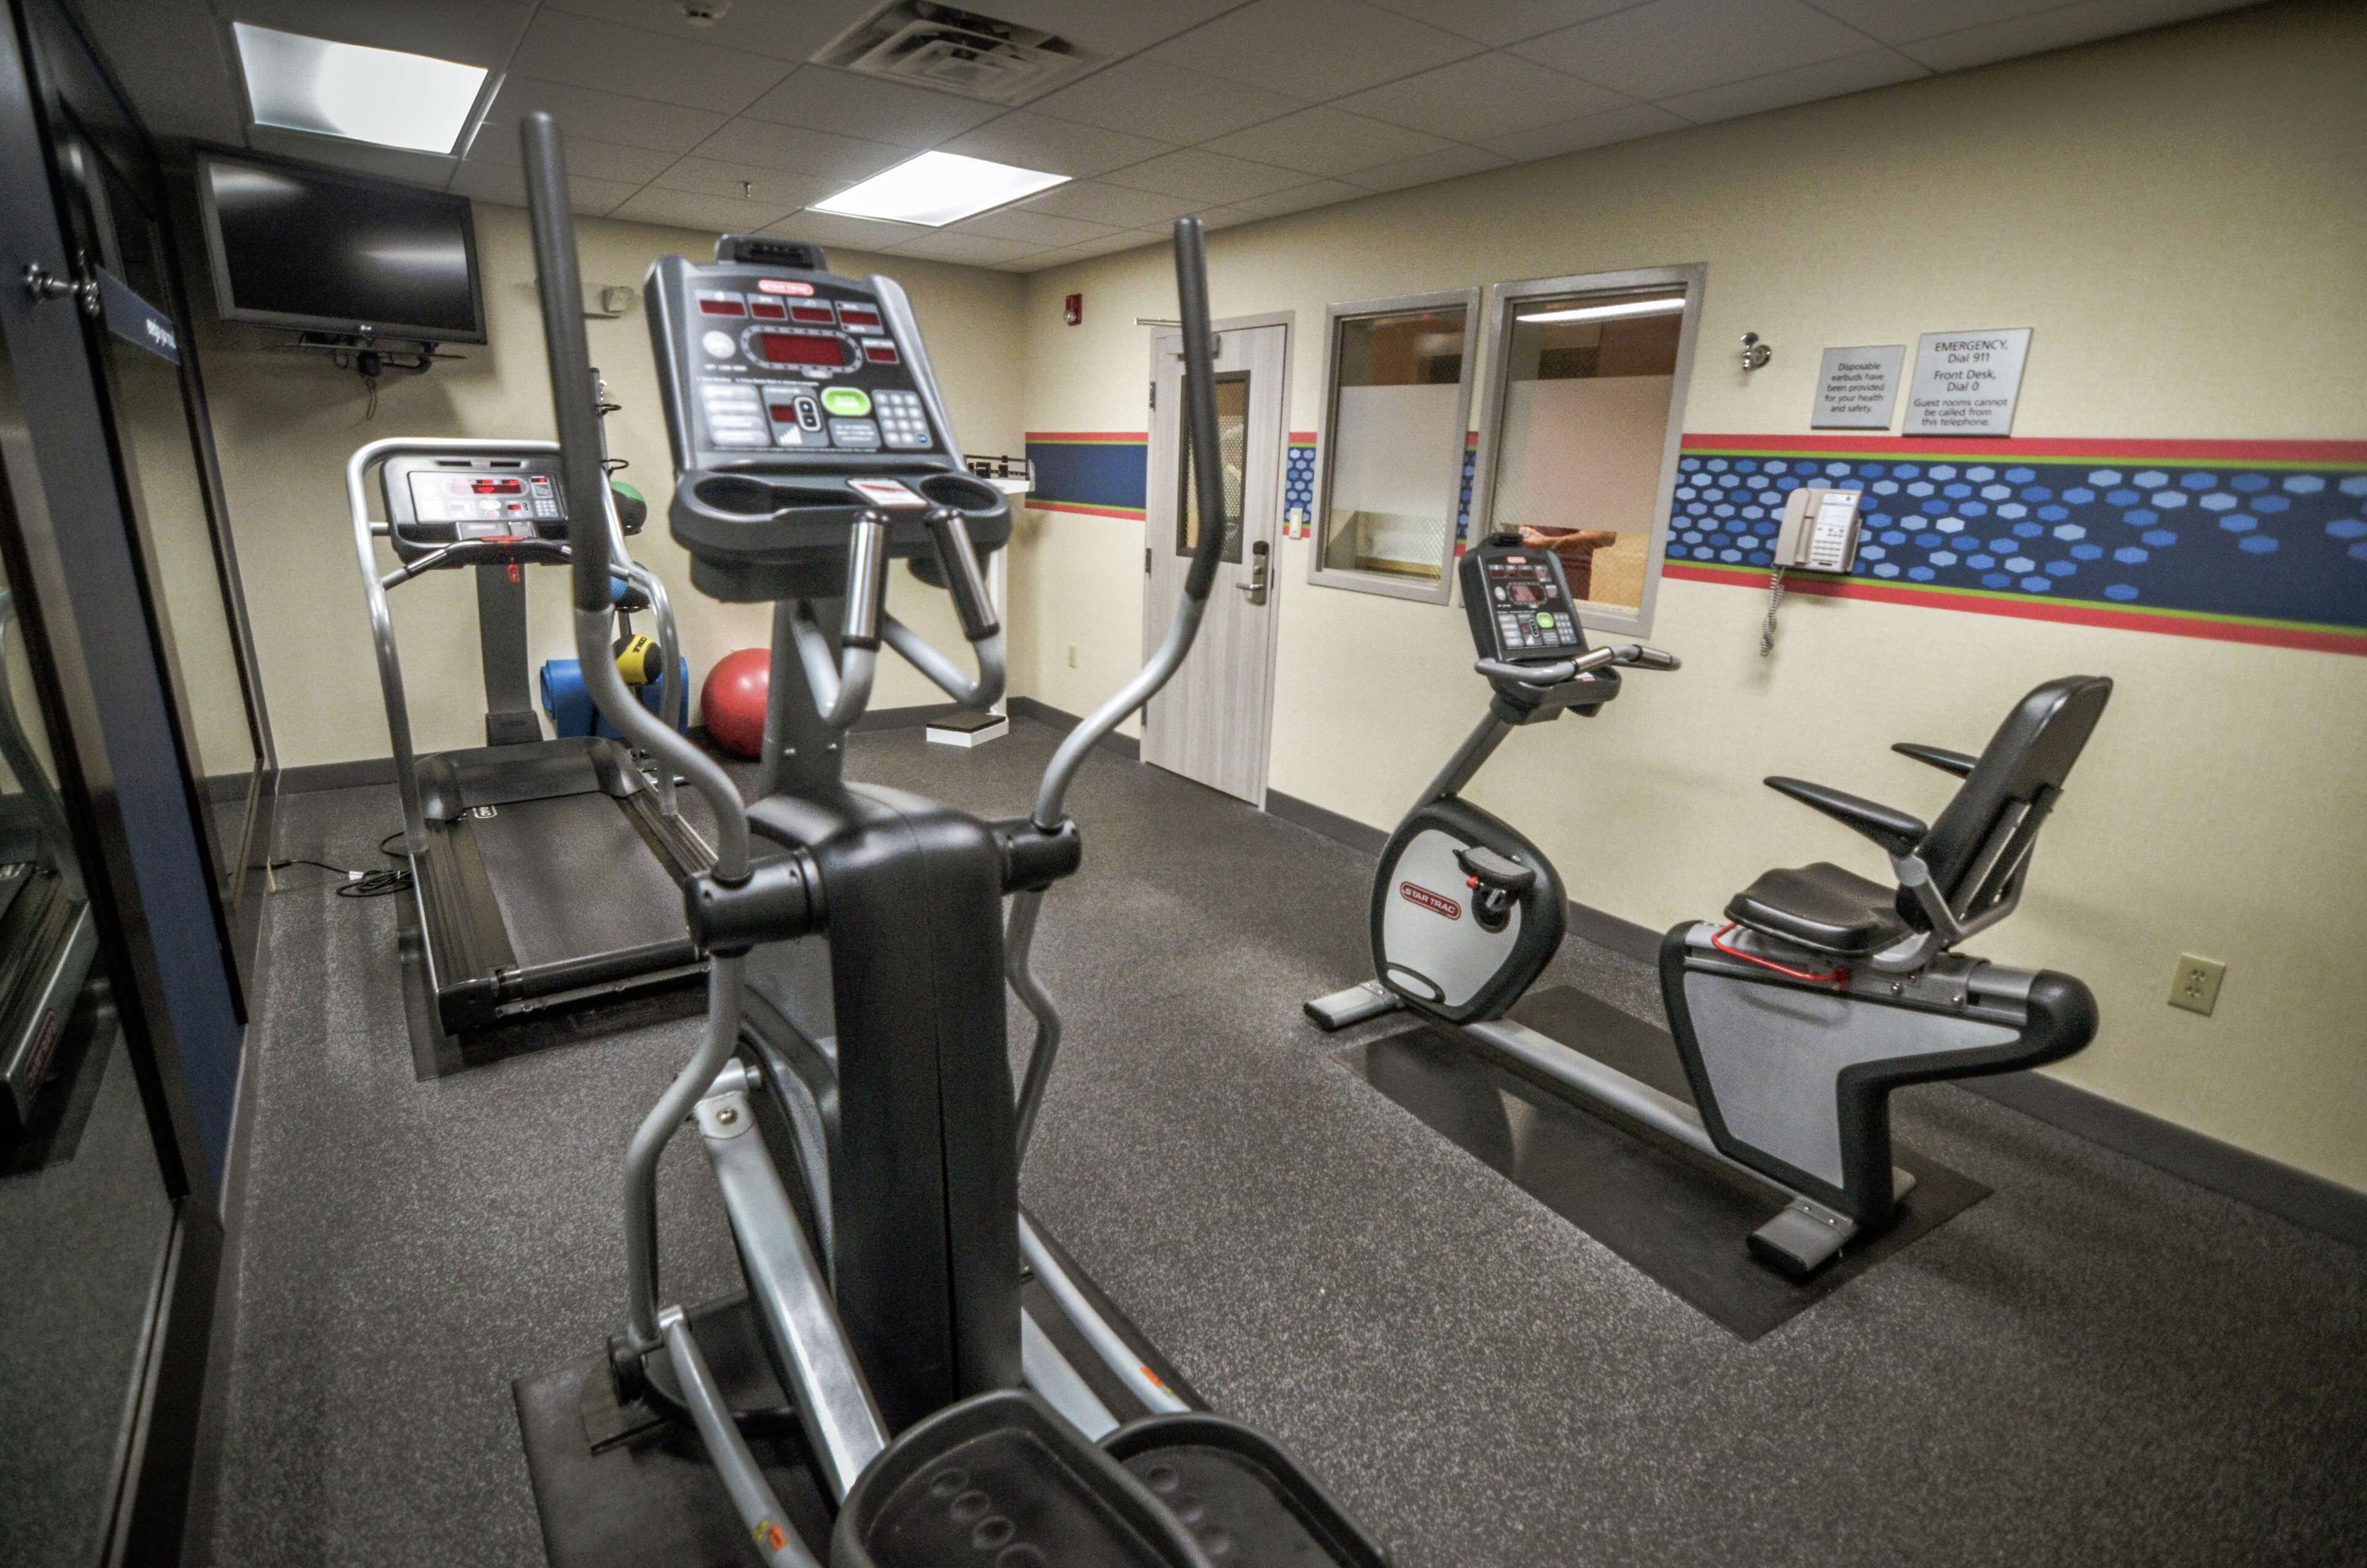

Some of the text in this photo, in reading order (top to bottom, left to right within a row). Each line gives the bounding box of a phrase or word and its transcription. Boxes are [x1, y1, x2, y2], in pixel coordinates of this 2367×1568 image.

[1935, 340, 2008, 352] EMERGENCY,
[1948, 353, 1990, 363] Dial 911
[1838, 363, 1881, 371] Disposable
[1831, 373, 1862, 381] earbuds
[1934, 369, 1997, 380] Front Desk,
[1828, 384, 1885, 393] been provided
[1947, 381, 1979, 392] Dial 0
[1838, 396, 1855, 404] your
[1848, 405, 1873, 414] safety.
[1938, 408, 1966, 416] called
[1969, 408, 1992, 416] from
[1941, 418, 1990, 427] telephone.
[1405, 889, 1456, 913] STAR TRAC
